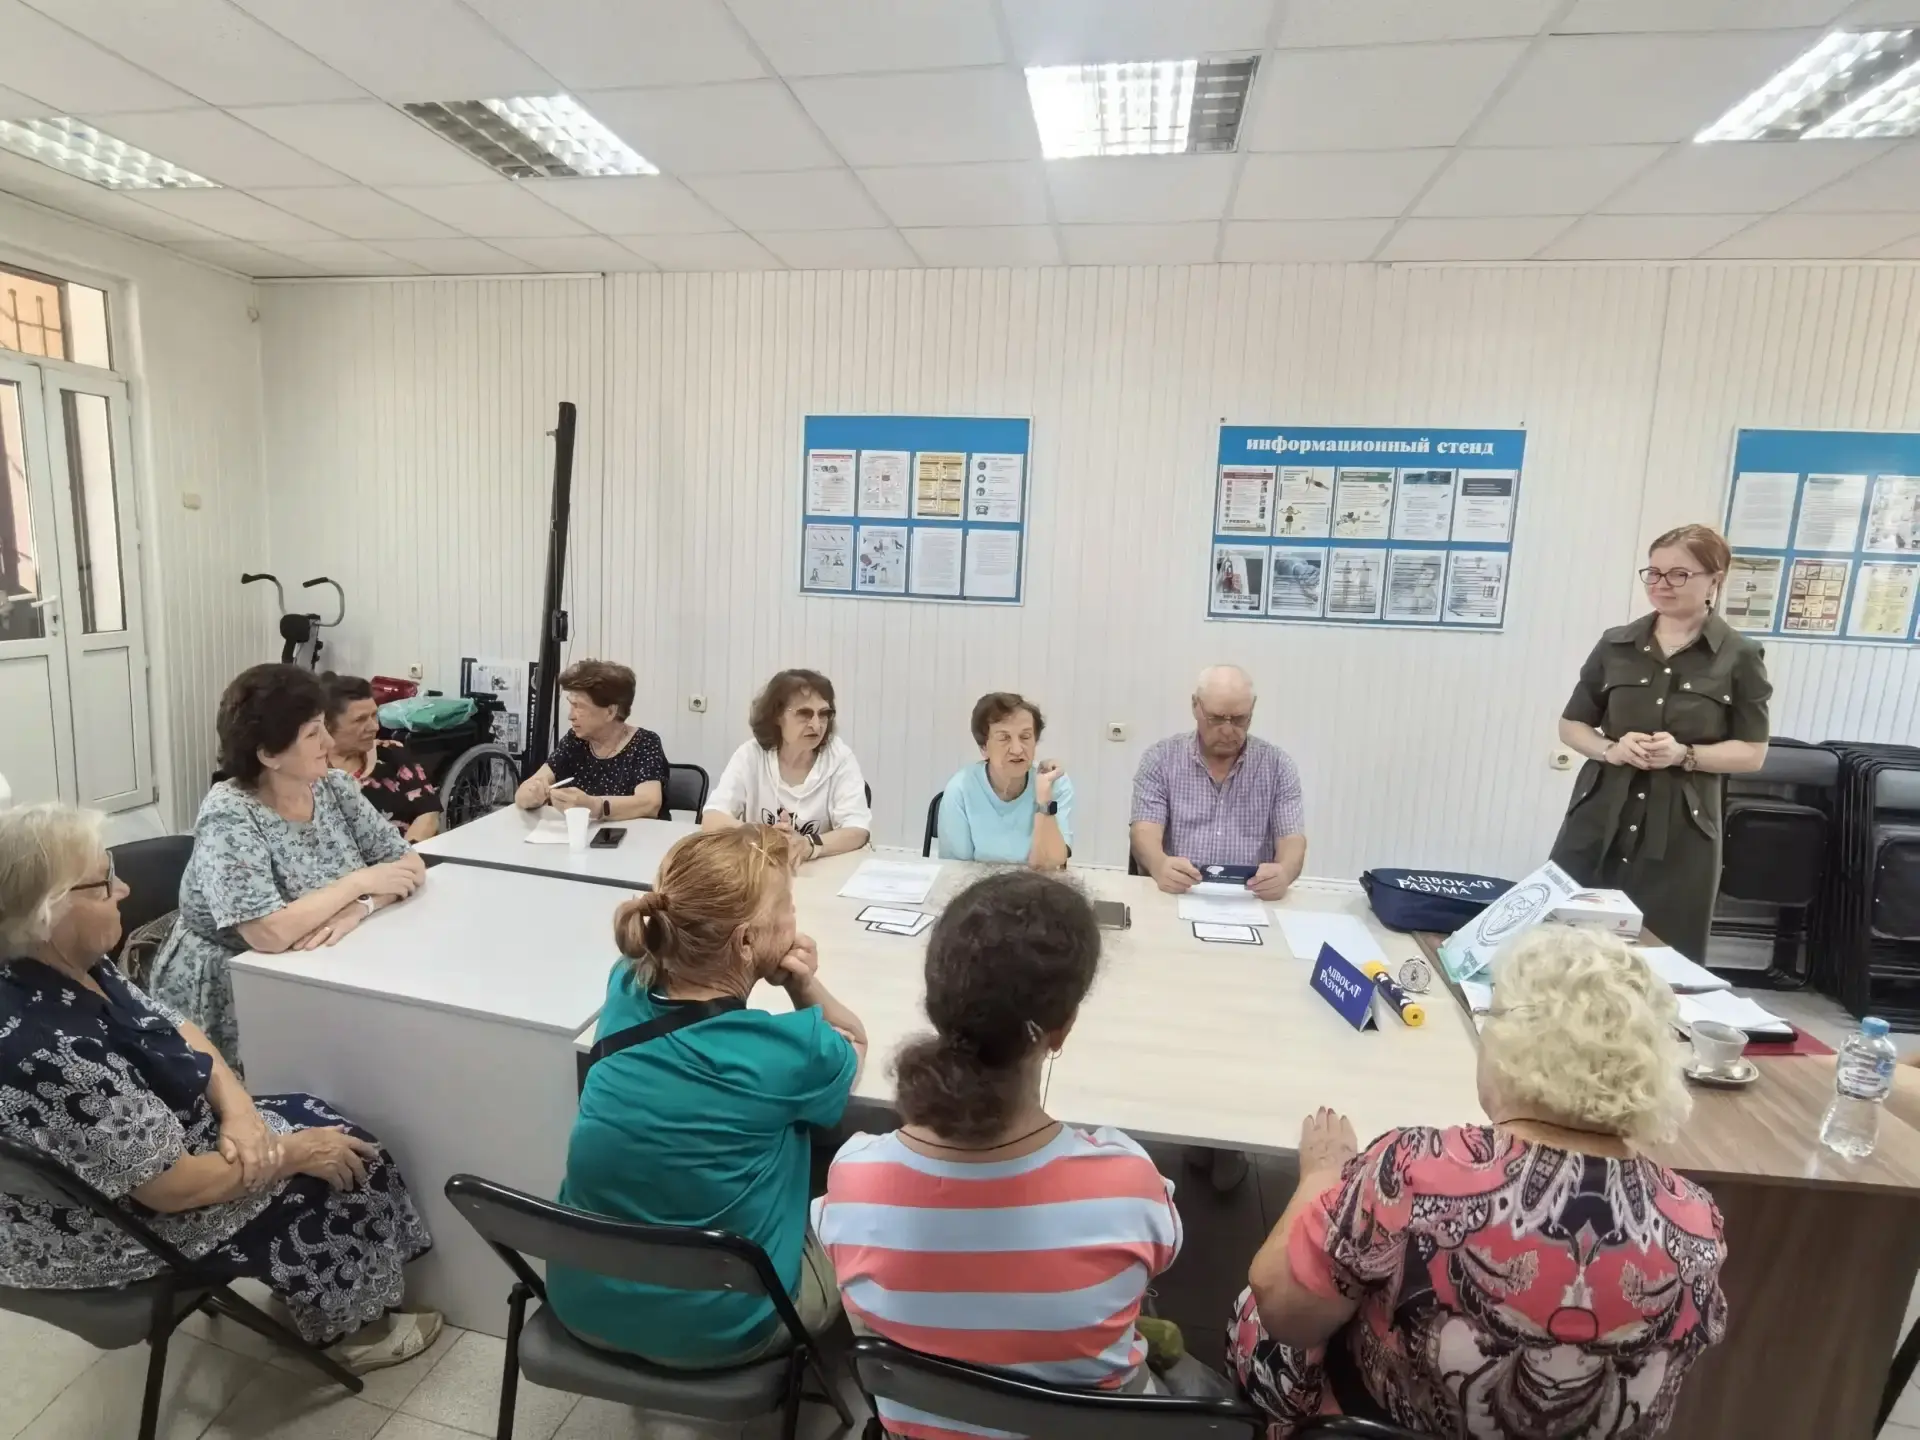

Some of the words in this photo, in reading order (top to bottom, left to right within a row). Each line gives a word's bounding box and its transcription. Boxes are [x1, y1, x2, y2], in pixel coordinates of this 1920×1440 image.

[1246, 435, 1430, 454] информационный
[1436, 440, 1495, 455] стенд
[1396, 878, 1472, 895] РАЗУМА
[1405, 875, 1496, 889] АДВОКАТ
[1319, 968, 1345, 1002] РАЗУМА
[1326, 965, 1362, 998] АДВОКАТ
